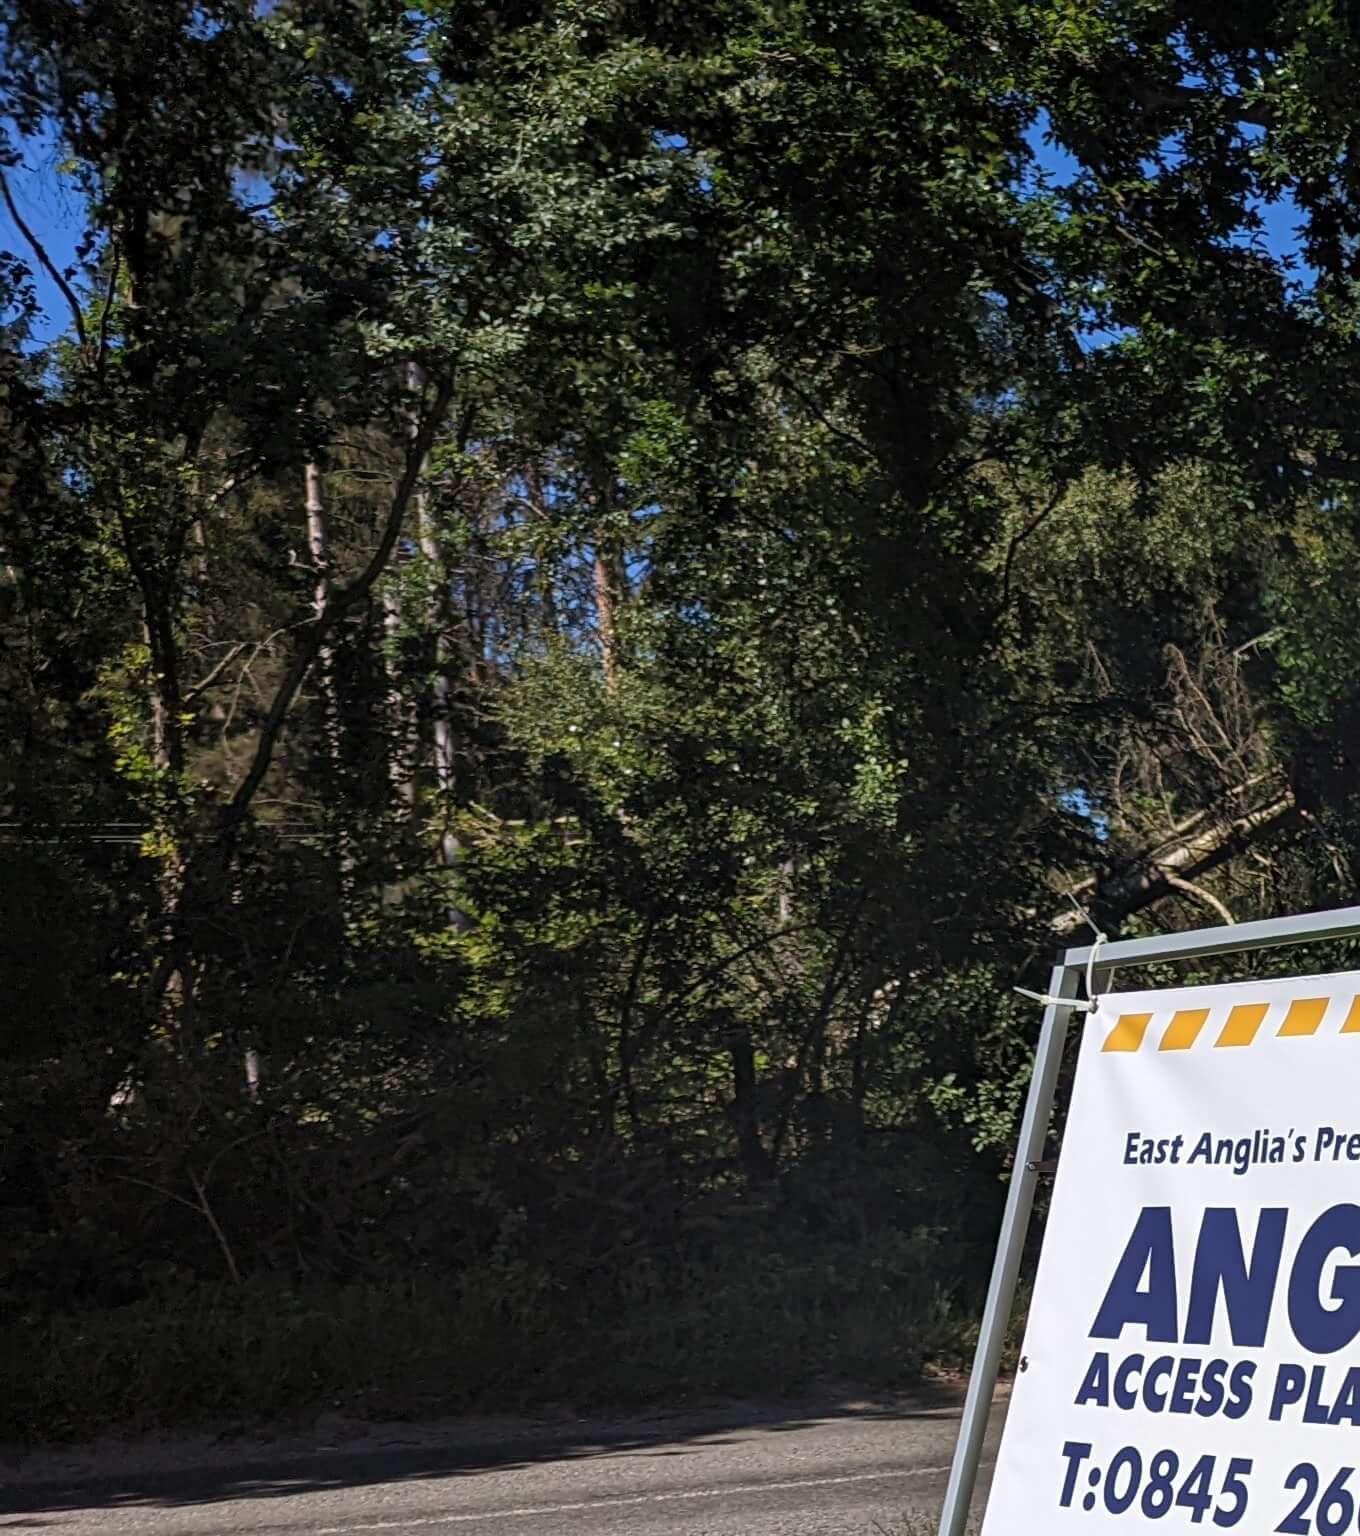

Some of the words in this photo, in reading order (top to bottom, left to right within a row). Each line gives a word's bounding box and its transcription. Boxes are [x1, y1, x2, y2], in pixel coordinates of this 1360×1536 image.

[1123, 1132, 1184, 1165] East
[1186, 1128, 1307, 1176] Anglia's
[1073, 1351, 1257, 1422] ACCESS
[1058, 1440, 1254, 1529] T:0845
